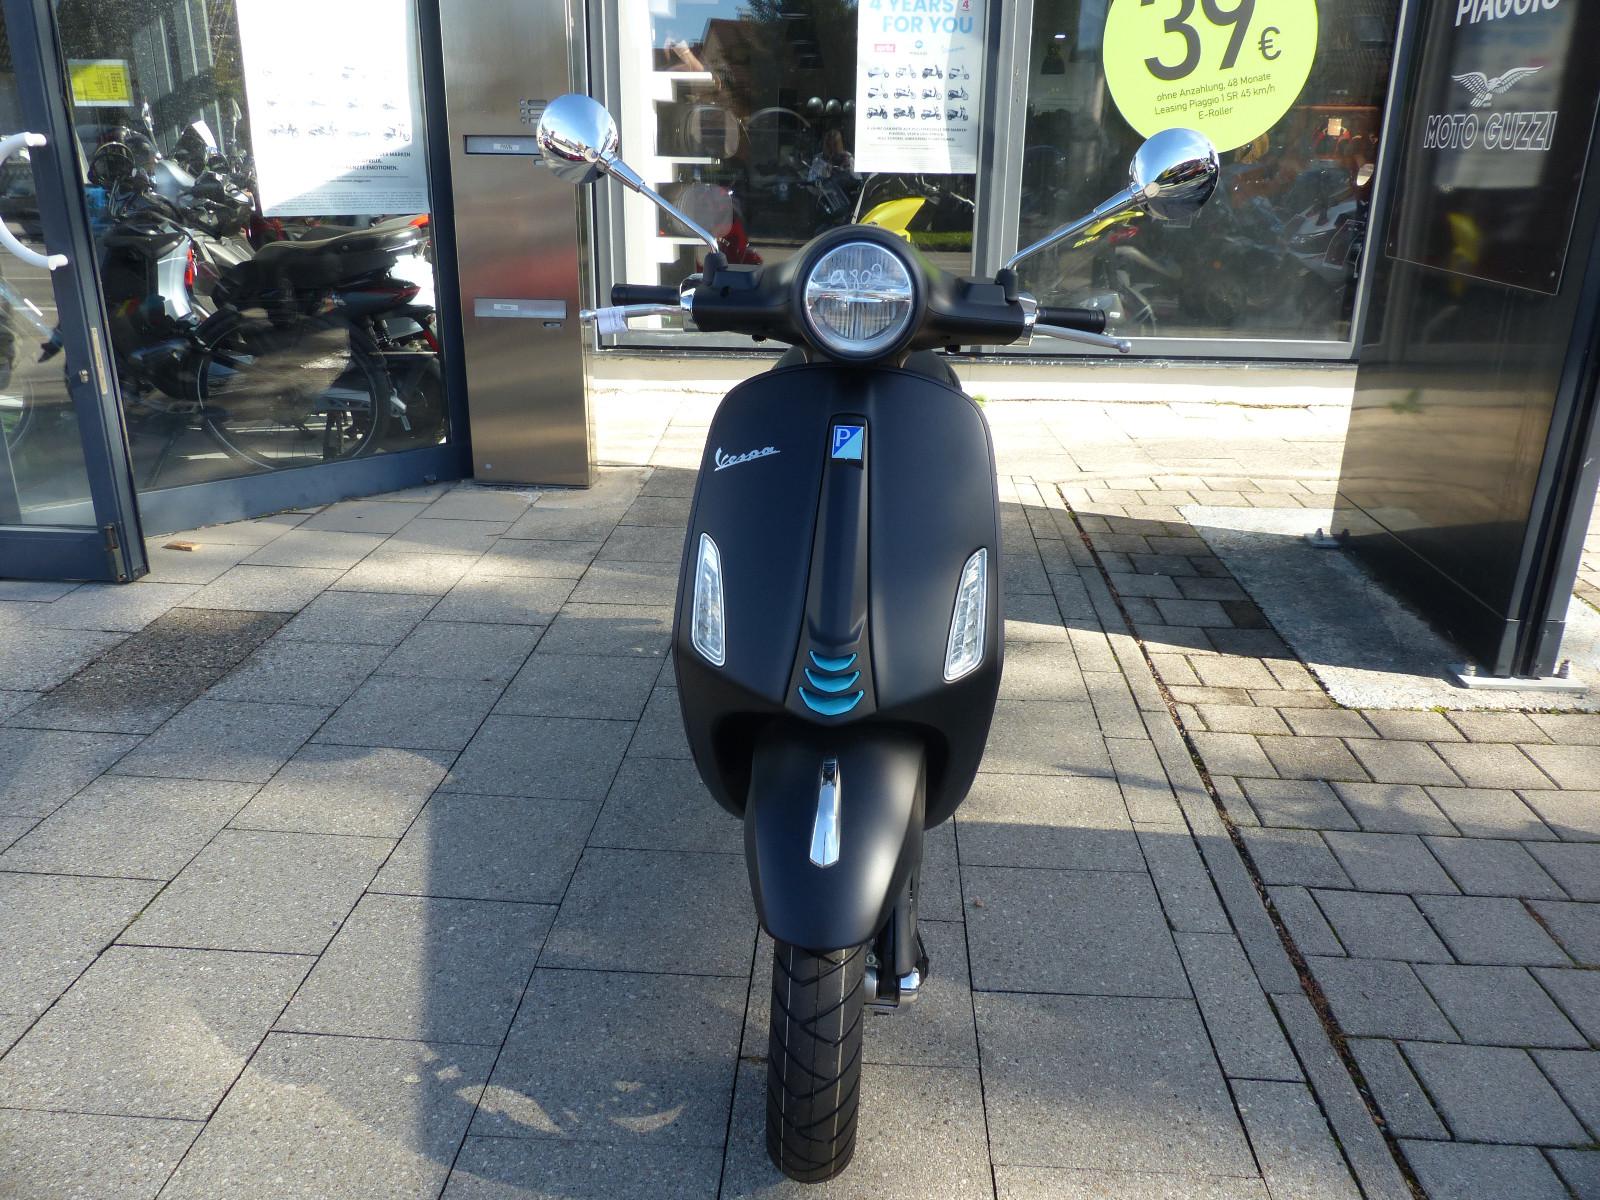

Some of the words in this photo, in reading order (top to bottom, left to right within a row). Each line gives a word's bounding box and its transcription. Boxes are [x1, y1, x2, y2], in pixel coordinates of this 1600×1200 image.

[889, 0, 954, 13] YEARS
[882, 15, 923, 33] FOR
[928, 15, 974, 34] YOU
[1140, 0, 1256, 81] 39
[1258, 26, 1282, 61] €
[1154, 102, 1187, 115] Leasing
[1189, 97, 1220, 109] Piaggio
[1226, 91, 1239, 101] SR
[1240, 88, 1252, 98] 45
[1253, 83, 1276, 96] km/h
[1157, 91, 1178, 102] ohne
[1179, 82, 1226, 97] Anzahlung,
[1227, 78, 1239, 88] 48
[1240, 72, 1272, 85] Monate
[1198, 106, 1234, 120] E-Roller
[1424, 113, 1479, 149] MOTO
[1484, 111, 1558, 150] GUZZI
[836, 428, 851, 447] P
[714, 446, 781, 471] Vespa
